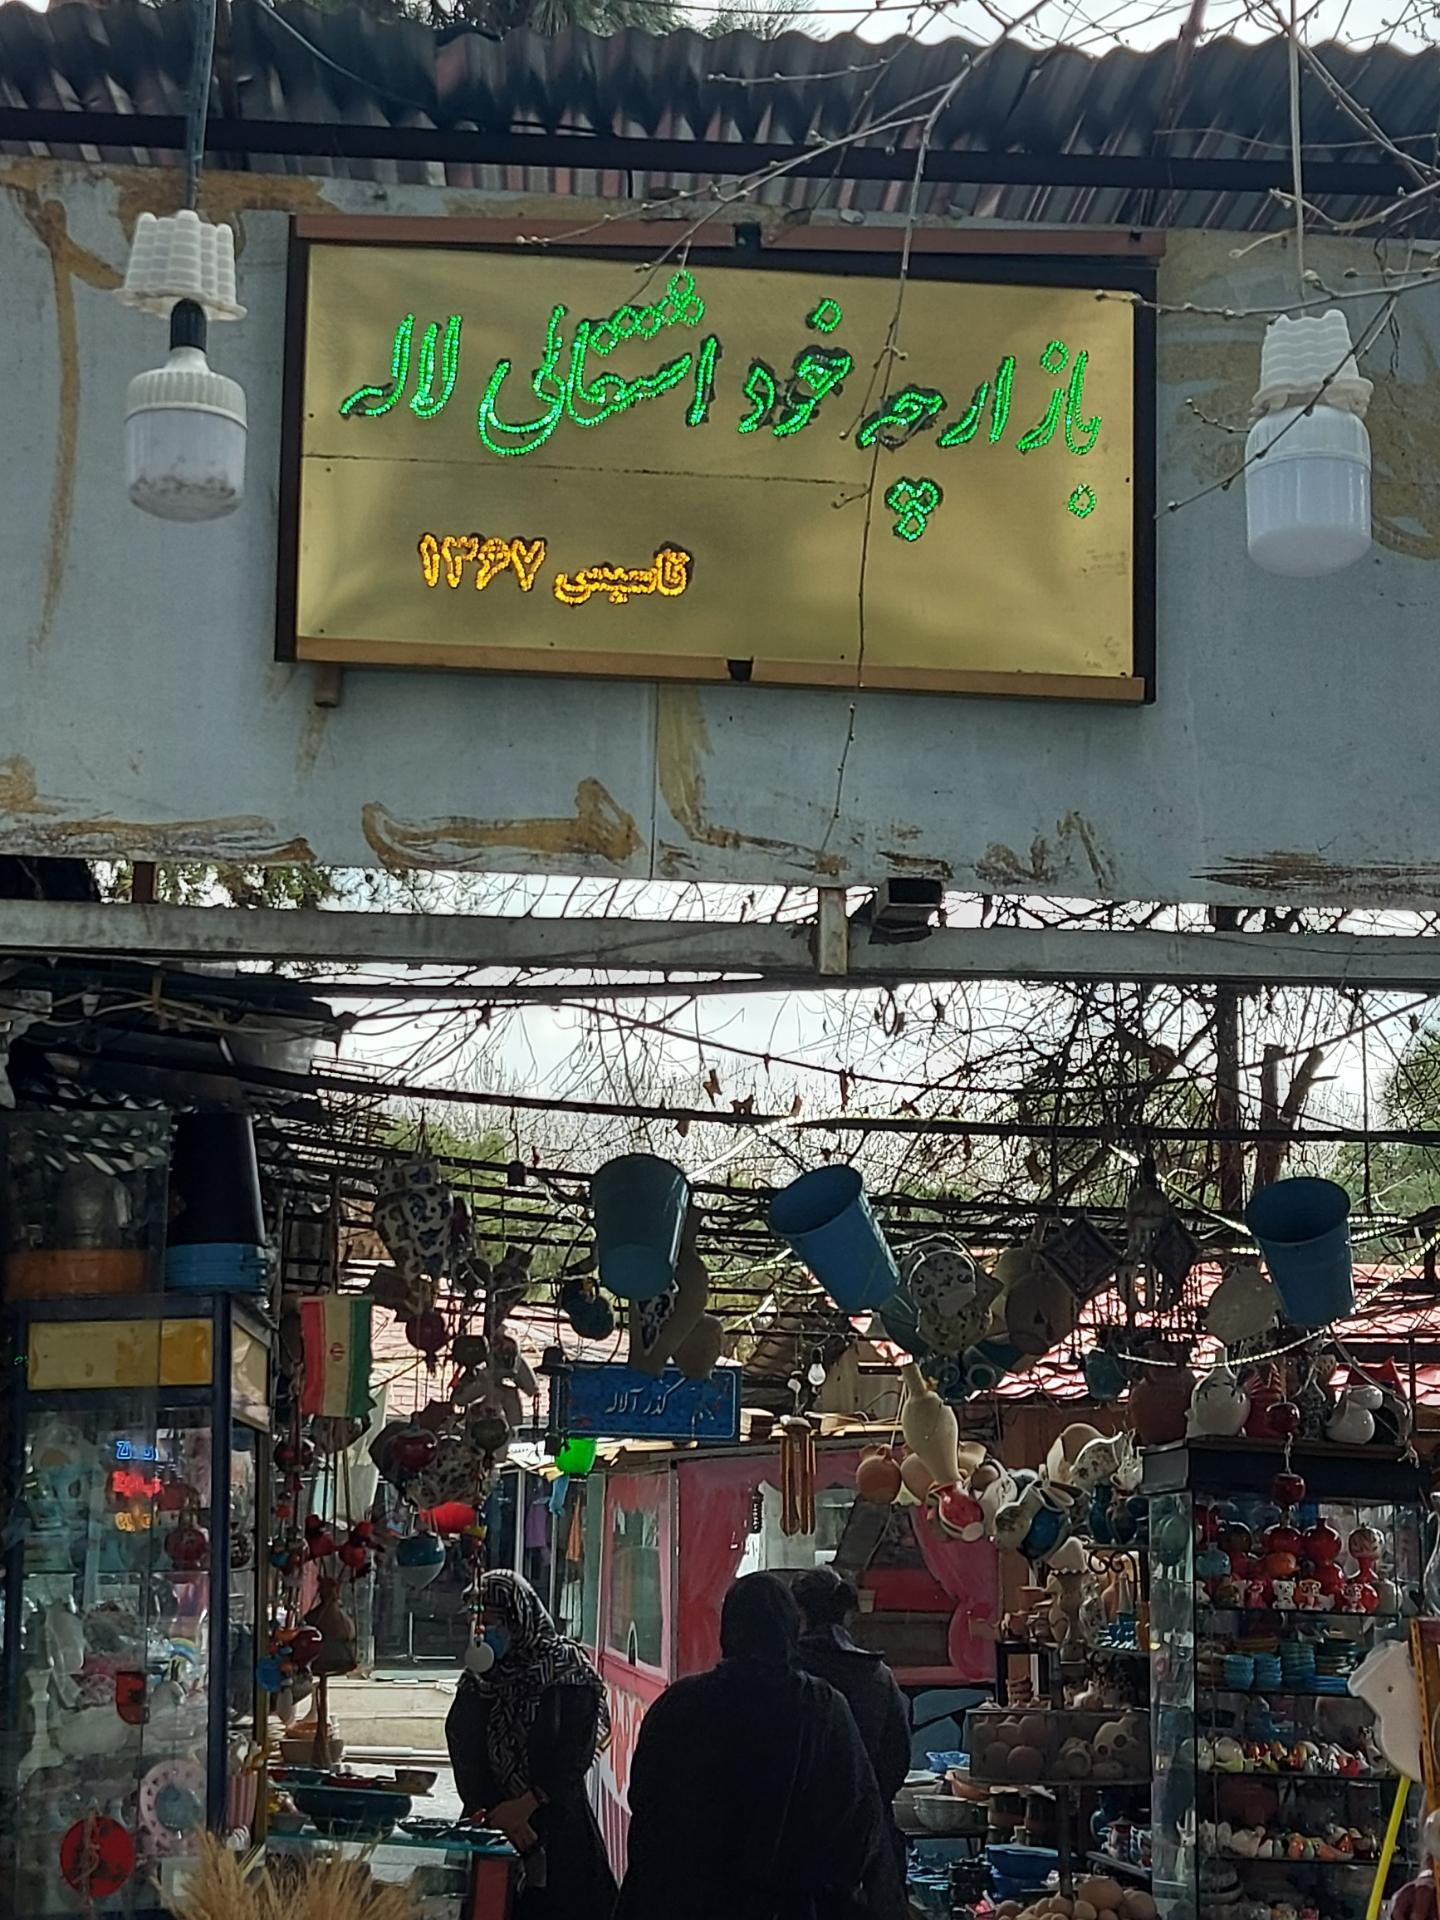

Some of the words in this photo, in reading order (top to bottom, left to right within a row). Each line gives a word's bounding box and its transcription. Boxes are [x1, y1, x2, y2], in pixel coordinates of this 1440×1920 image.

[337, 311, 464, 421] لاله
[856, 338, 1104, 543] بازارچه
[419, 533, 545, 590] ۱۳۶۷
[642, 1376, 687, 1416] گذر
